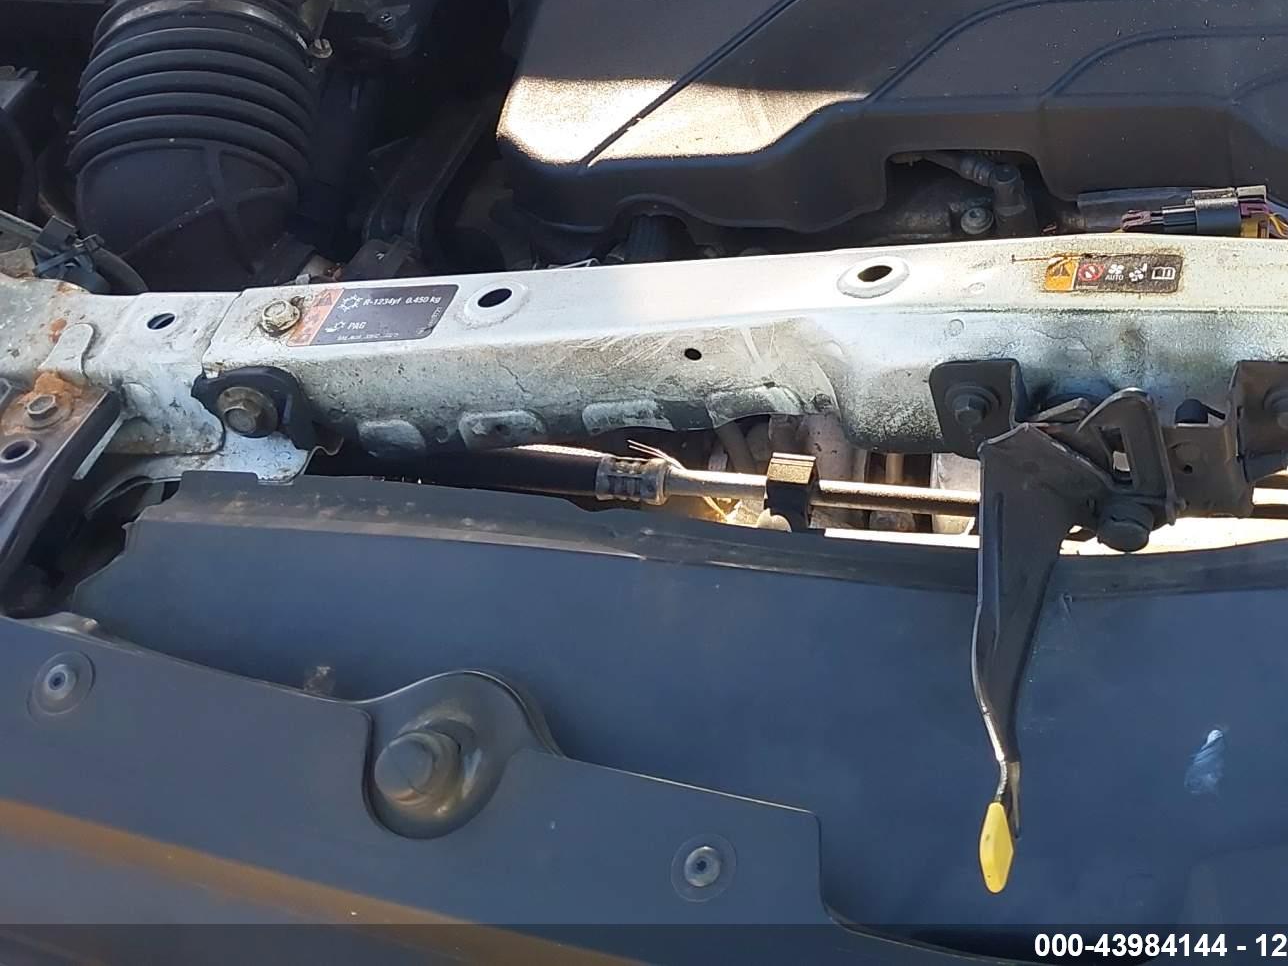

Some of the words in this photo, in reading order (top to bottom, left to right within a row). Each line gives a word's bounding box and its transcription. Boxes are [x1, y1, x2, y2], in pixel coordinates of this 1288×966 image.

[362, 297, 402, 306] R-1234yf
[430, 296, 441, 304] kg
[347, 321, 367, 330] PAG
